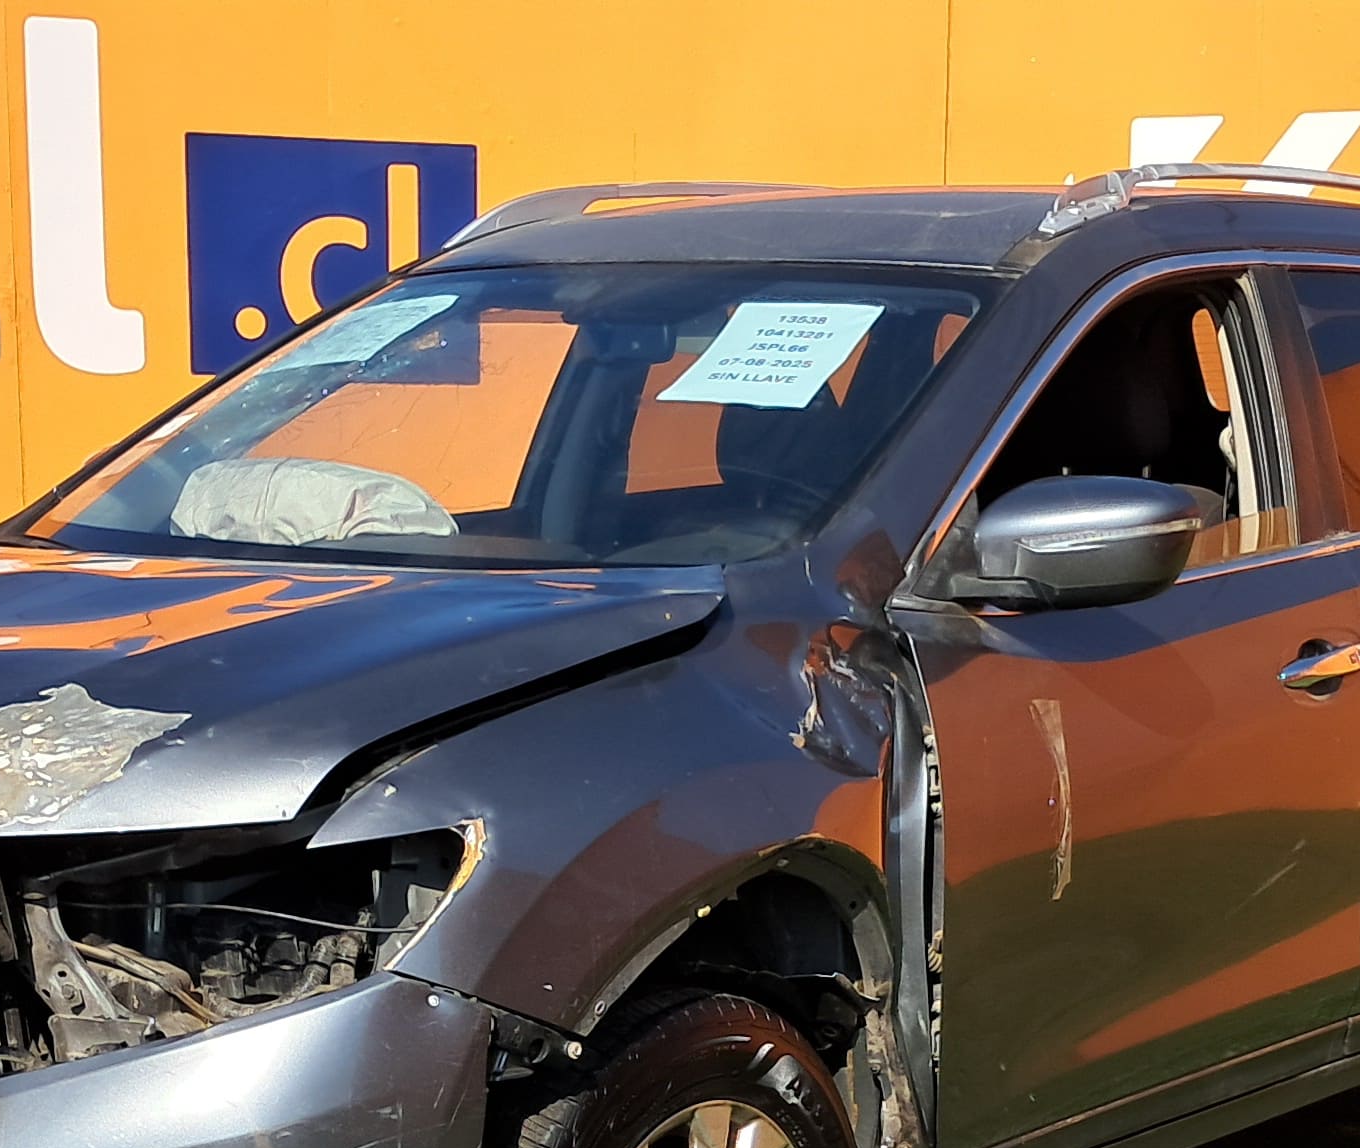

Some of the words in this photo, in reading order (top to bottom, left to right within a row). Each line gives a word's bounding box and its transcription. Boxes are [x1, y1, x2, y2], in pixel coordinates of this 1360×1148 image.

[747, 343, 809, 353] JSPL66
[718, 357, 813, 369] 07-08-2025
[707, 371, 741, 382] SIN
[742, 373, 798, 383] LLAVE
